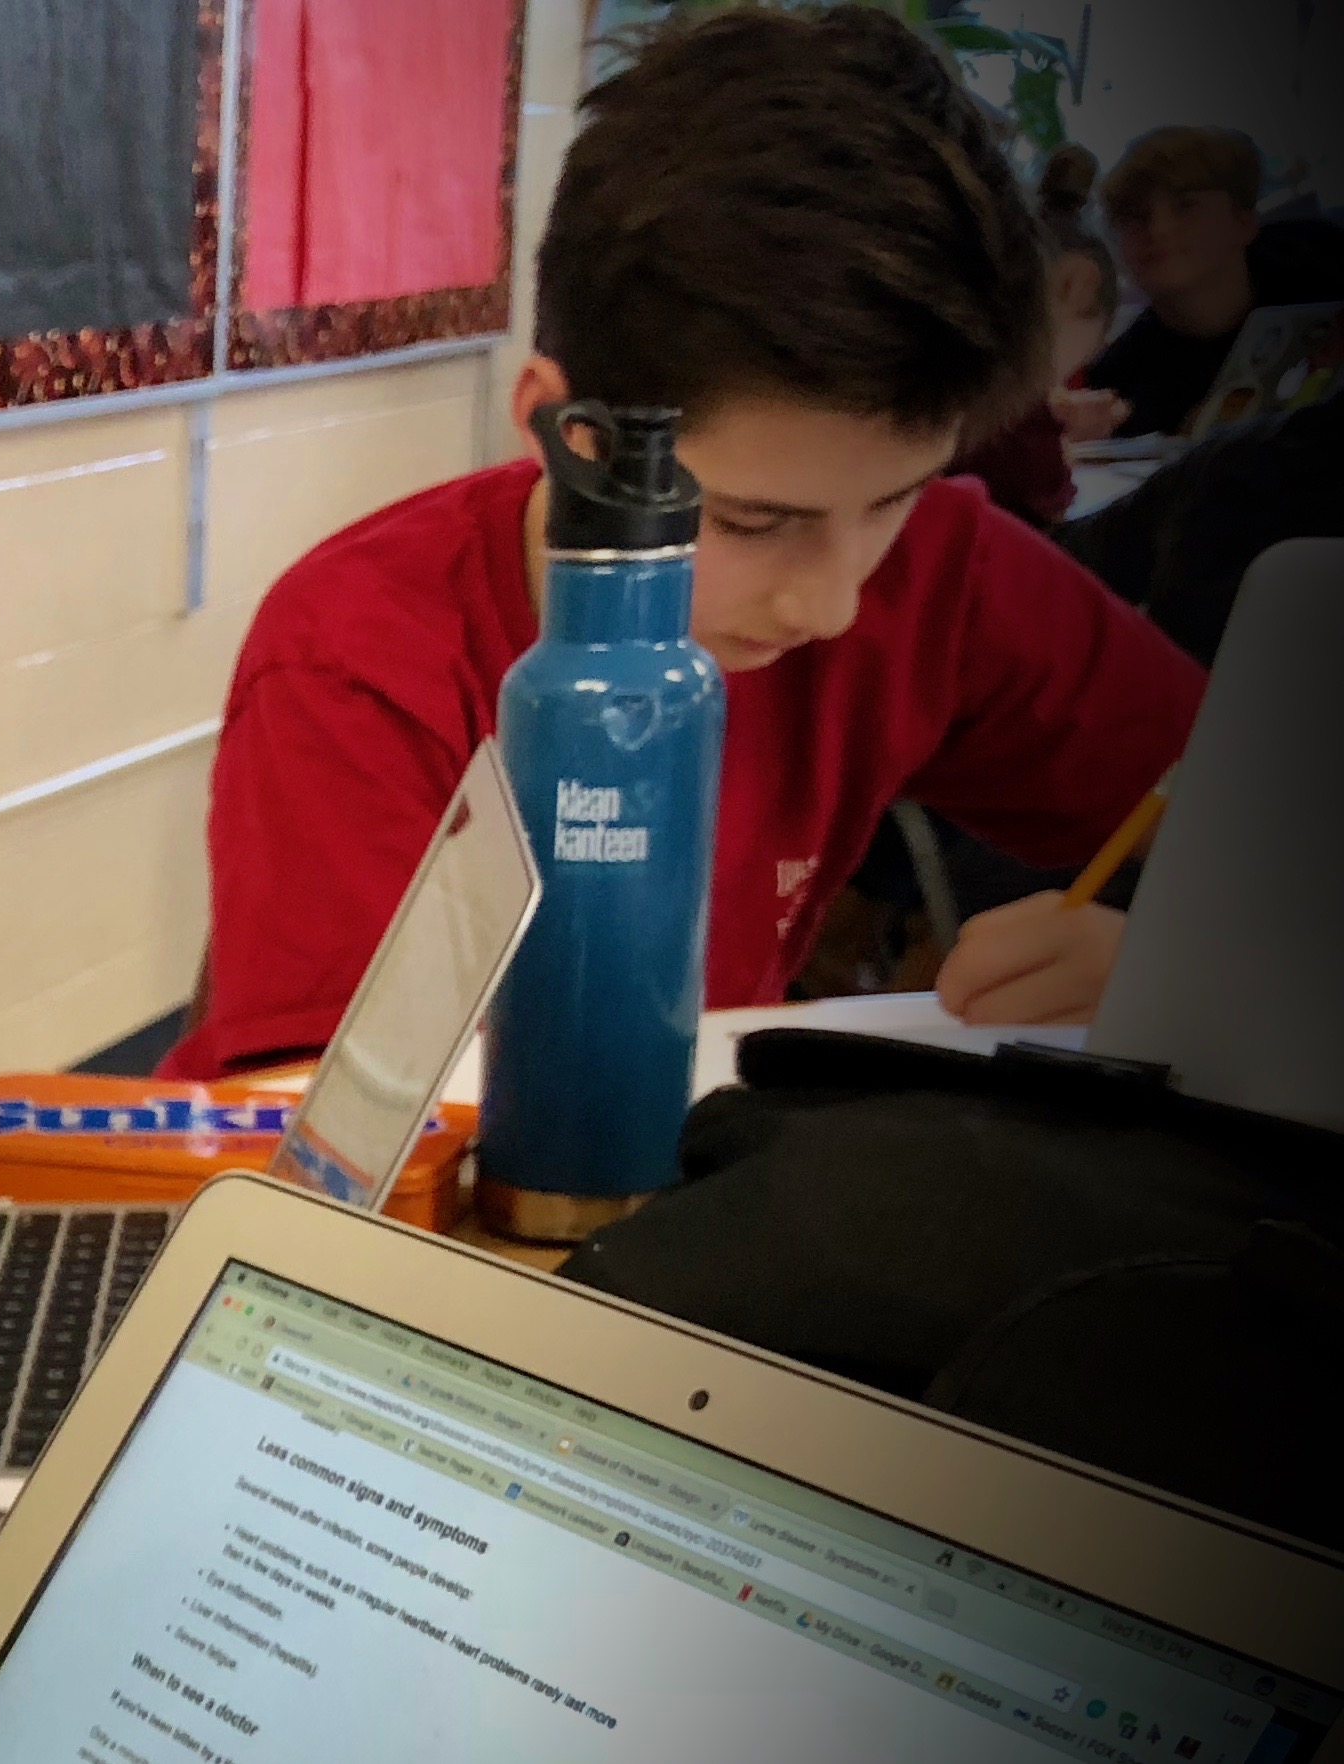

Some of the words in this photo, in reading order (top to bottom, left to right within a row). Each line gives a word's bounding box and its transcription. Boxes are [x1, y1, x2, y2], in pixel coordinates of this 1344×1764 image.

[556, 779, 621, 822] klean
[554, 820, 648, 862] kanteen
[256, 1435, 288, 1461] Less
[288, 1453, 346, 1487] common
[345, 1480, 384, 1505] signs
[384, 1498, 415, 1519] and
[413, 1511, 488, 1554] symptoms
[234, 1475, 270, 1501] Several
[269, 1495, 299, 1516] weeks
[299, 1509, 322, 1526] after
[364, 1541, 393, 1562] some
[391, 1555, 428, 1579] people
[428, 1571, 472, 1600] develop:
[567, 1512, 608, 1534] calendar
[222, 1543, 244, 1561] than
[252, 1557, 269, 1575] few
[268, 1568, 293, 1588] days
[291, 1581, 305, 1592] or
[777, 1530, 816, 1553] disease
[825, 1549, 880, 1580] Symptoms
[190, 1600, 213, 1618] Liver
[212, 1612, 270, 1650] inflammation
[754, 1592, 787, 1615] Netflix
[173, 1626, 206, 1652] Severe
[233, 1526, 260, 1545] Heart
[303, 1563, 329, 1581] such
[327, 1575, 342, 1588] as
[341, 1582, 356, 1595] an
[356, 1589, 398, 1616] irregular
[449, 1635, 481, 1659] Heart
[478, 1652, 530, 1685] problems
[529, 1678, 562, 1703] rarely
[563, 1693, 586, 1713] last
[585, 1706, 617, 1729] more
[813, 1618, 832, 1636] My
[831, 1626, 861, 1647] Drive
[870, 1643, 910, 1669] Google
[1101, 1616, 1137, 1639] Wed
[1166, 1640, 1195, 1662] PM
[131, 1652, 166, 1682] When
[165, 1672, 181, 1691] to
[180, 1684, 204, 1705] see
[204, 1698, 215, 1712] a
[214, 1704, 259, 1736] doctor
[955, 1681, 1002, 1711] Classes
[147, 1713, 172, 1734] been
[171, 1728, 200, 1752] bitten
[1032, 1715, 1077, 1742] Soccer
[1087, 1738, 1116, 1759] FOX
